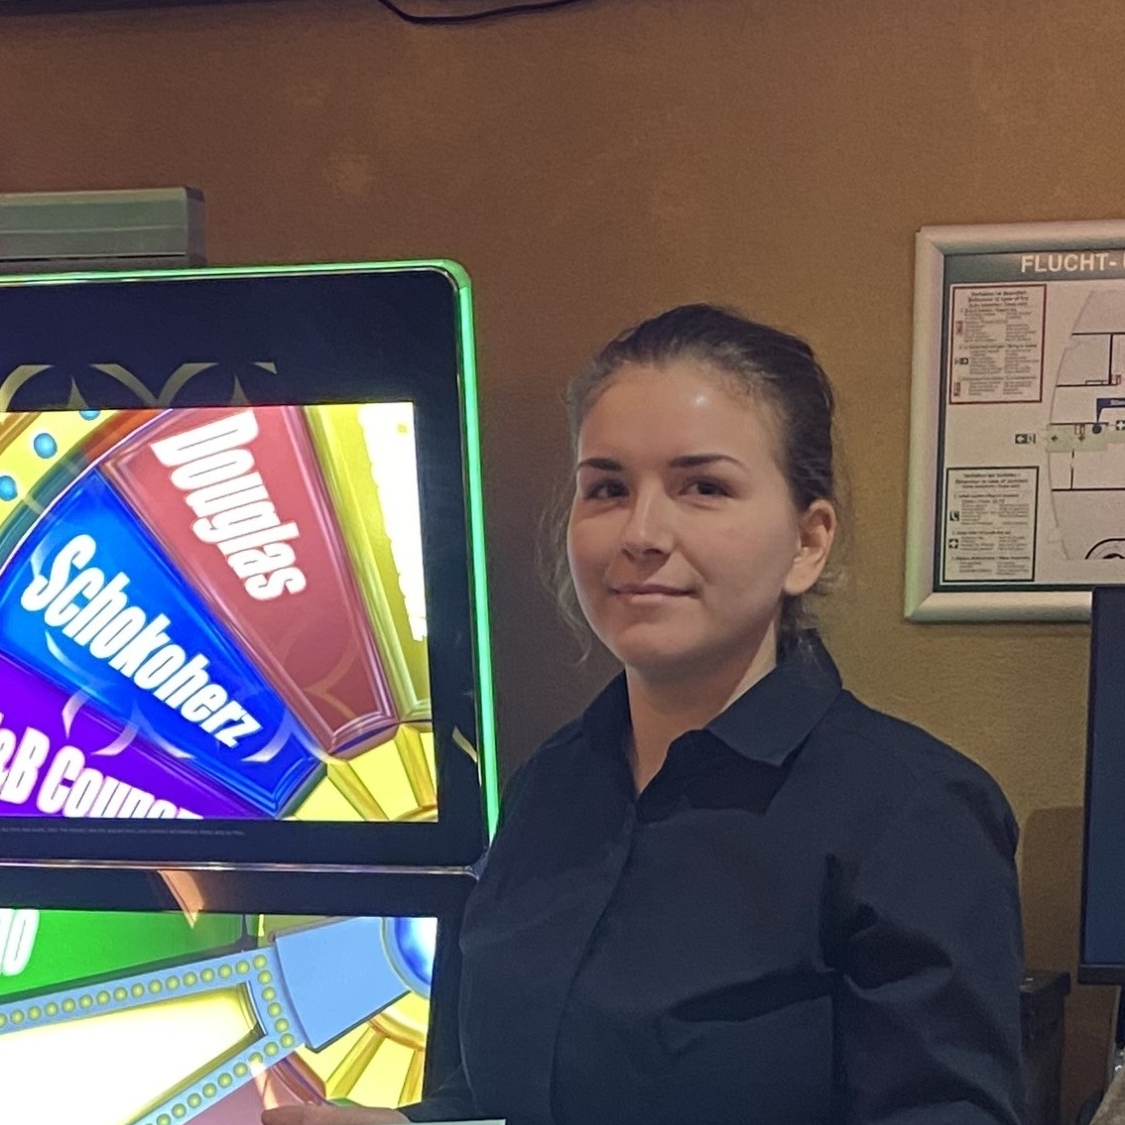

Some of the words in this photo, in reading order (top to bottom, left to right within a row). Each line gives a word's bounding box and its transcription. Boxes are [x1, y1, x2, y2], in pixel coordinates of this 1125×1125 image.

[1020, 252, 1117, 273] FLUCHT-
[149, 408, 307, 601] Douglas
[20, 533, 264, 750] Schokoherz
